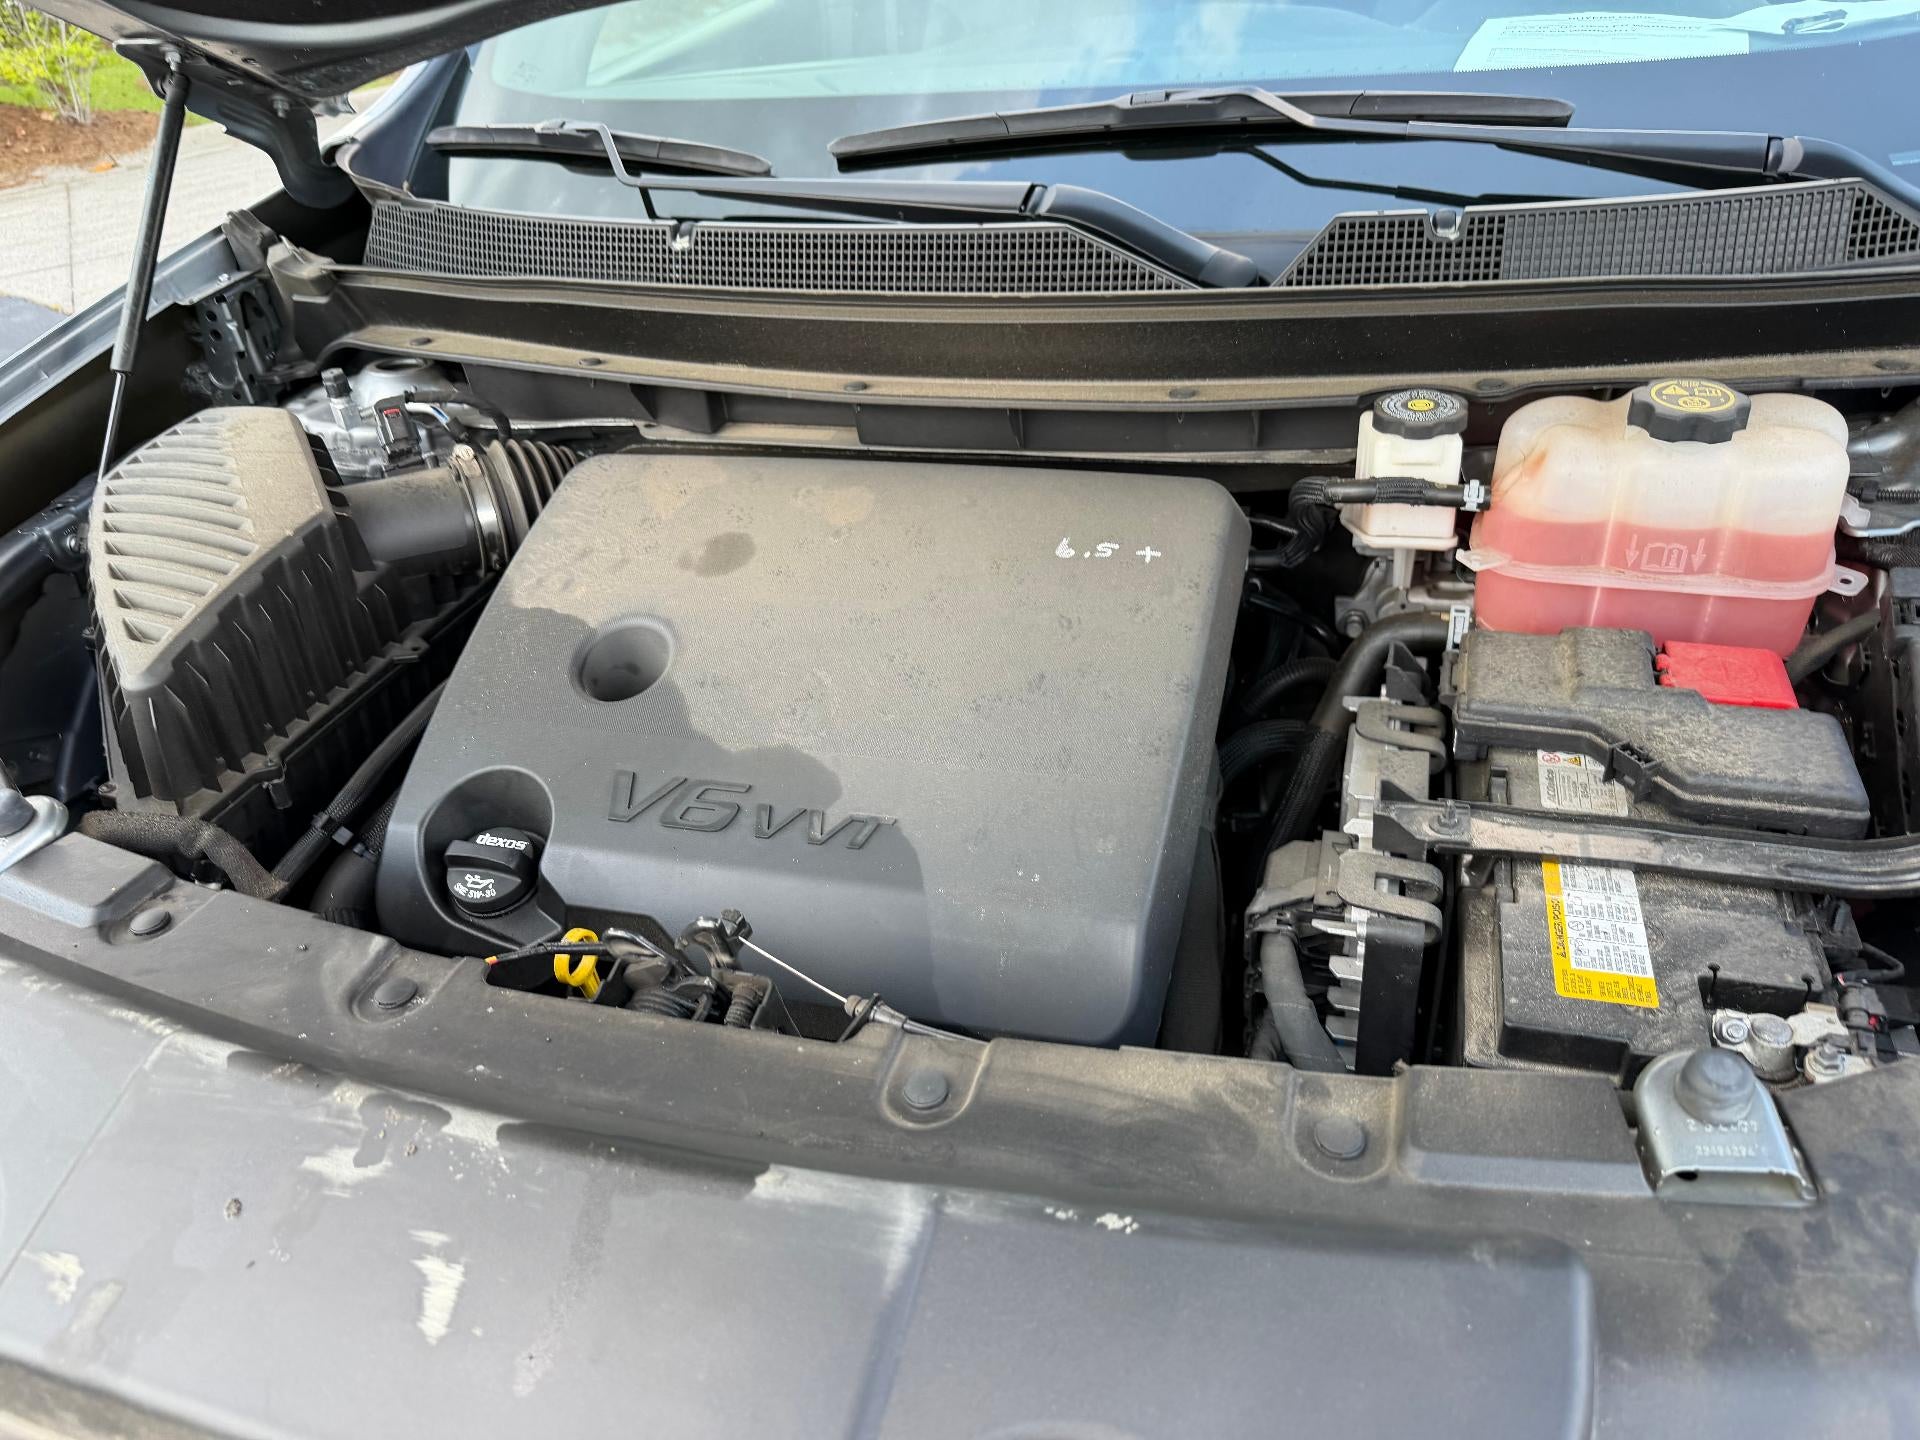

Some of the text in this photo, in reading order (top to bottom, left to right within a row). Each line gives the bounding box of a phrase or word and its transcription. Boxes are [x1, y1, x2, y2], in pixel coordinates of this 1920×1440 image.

[1054, 537, 1120, 559] 6.5
[607, 769, 897, 850] V6 VVT
[475, 833, 528, 850] dexos
